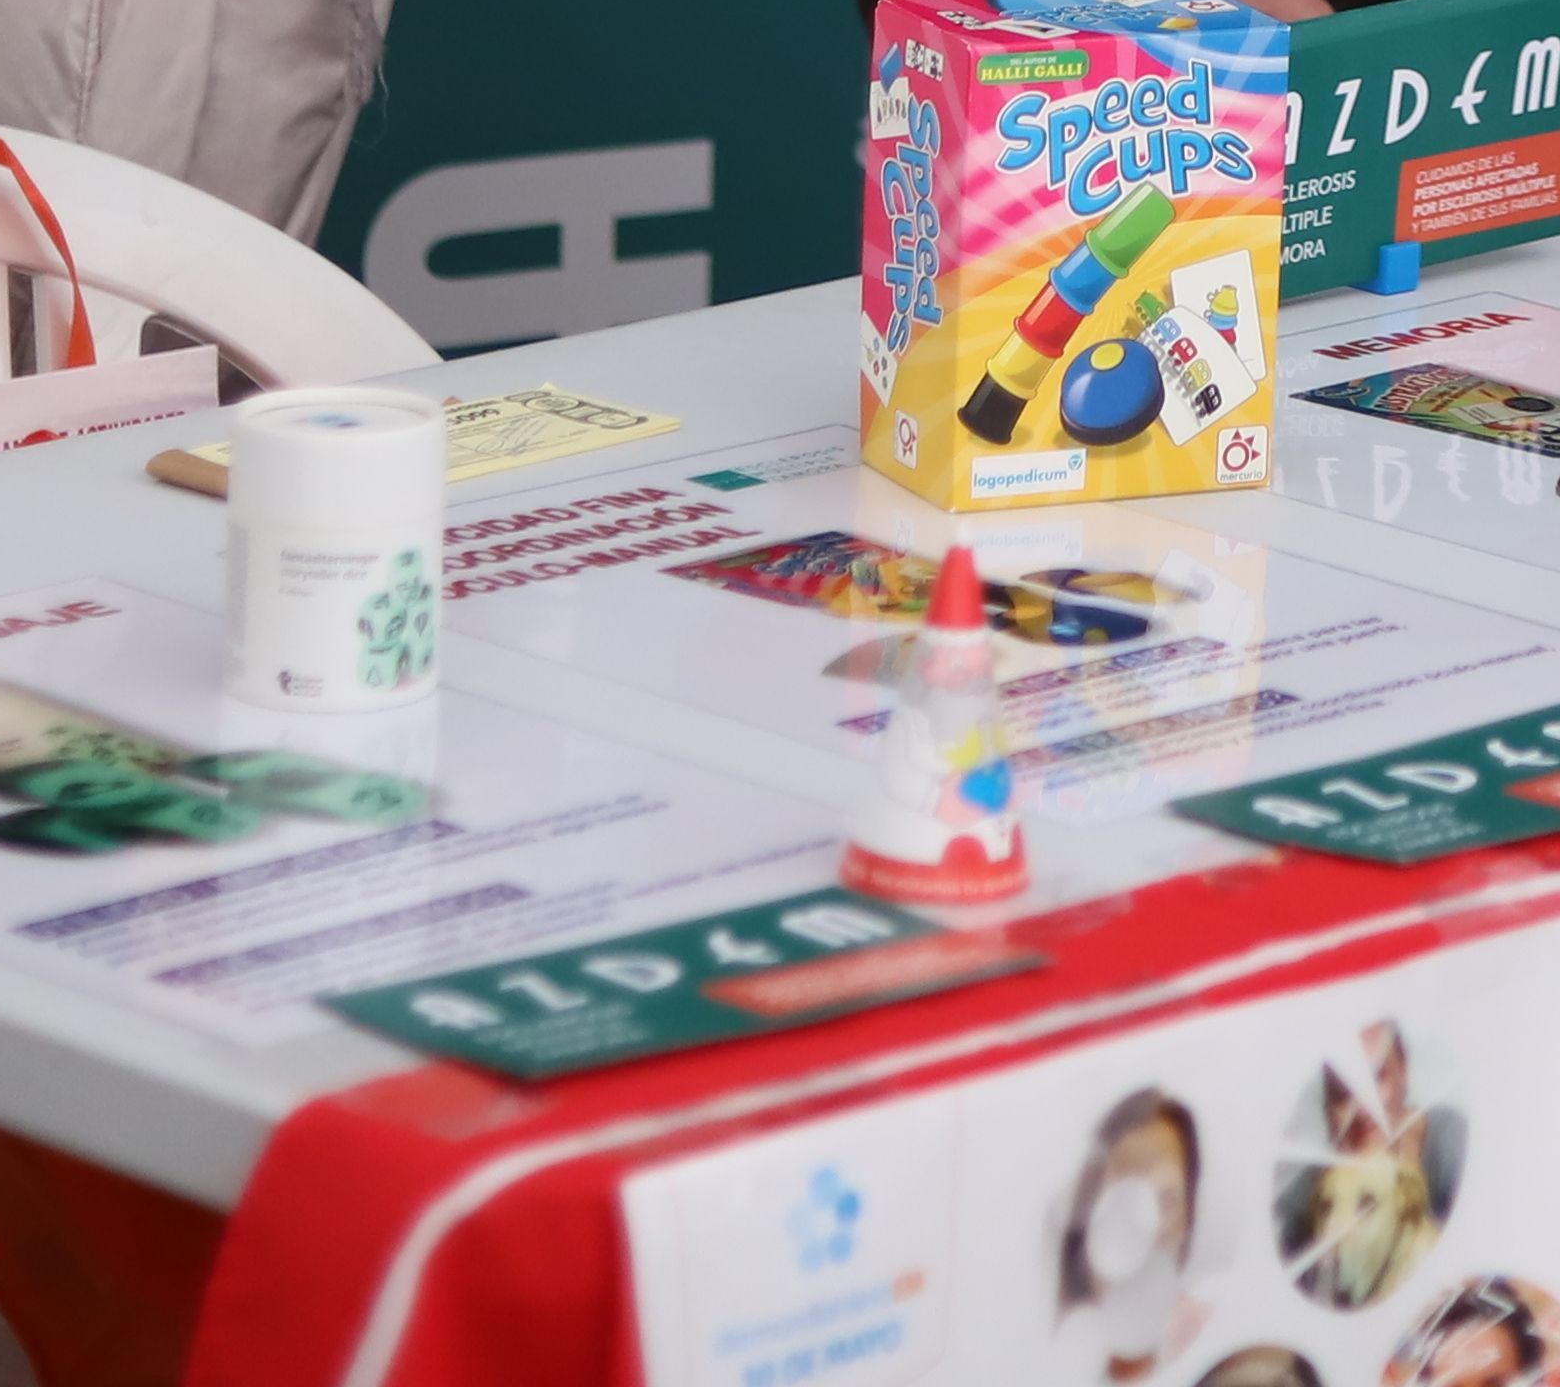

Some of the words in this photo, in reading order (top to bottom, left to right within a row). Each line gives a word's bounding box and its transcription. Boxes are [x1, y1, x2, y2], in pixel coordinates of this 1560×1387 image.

[981, 67, 1029, 81] HALLI
[1034, 63, 1083, 77] GALLI
[996, 59, 1214, 187] Speed
[1066, 127, 1257, 218] Cups
[1417, 160, 1476, 184] CUIDAMOS
[1478, 156, 1492, 170] DE
[1495, 152, 1516, 166] LAS
[1282, 170, 1356, 204] CLEROSIS
[1415, 177, 1474, 200] PERSONAS
[907, 92, 944, 328] Speed
[1282, 206, 1333, 234] LTIPLE
[1413, 202, 1437, 217] POR
[881, 157, 915, 355] Cups
[1281, 239, 1326, 265] MORA
[1312, 311, 1532, 360] MEMORIA
[973, 468, 1068, 488] logopedicum
[1220, 470, 1263, 481] mercurio
[569, 487, 686, 513] FINA
[443, 501, 734, 575] OORDINACIÓN
